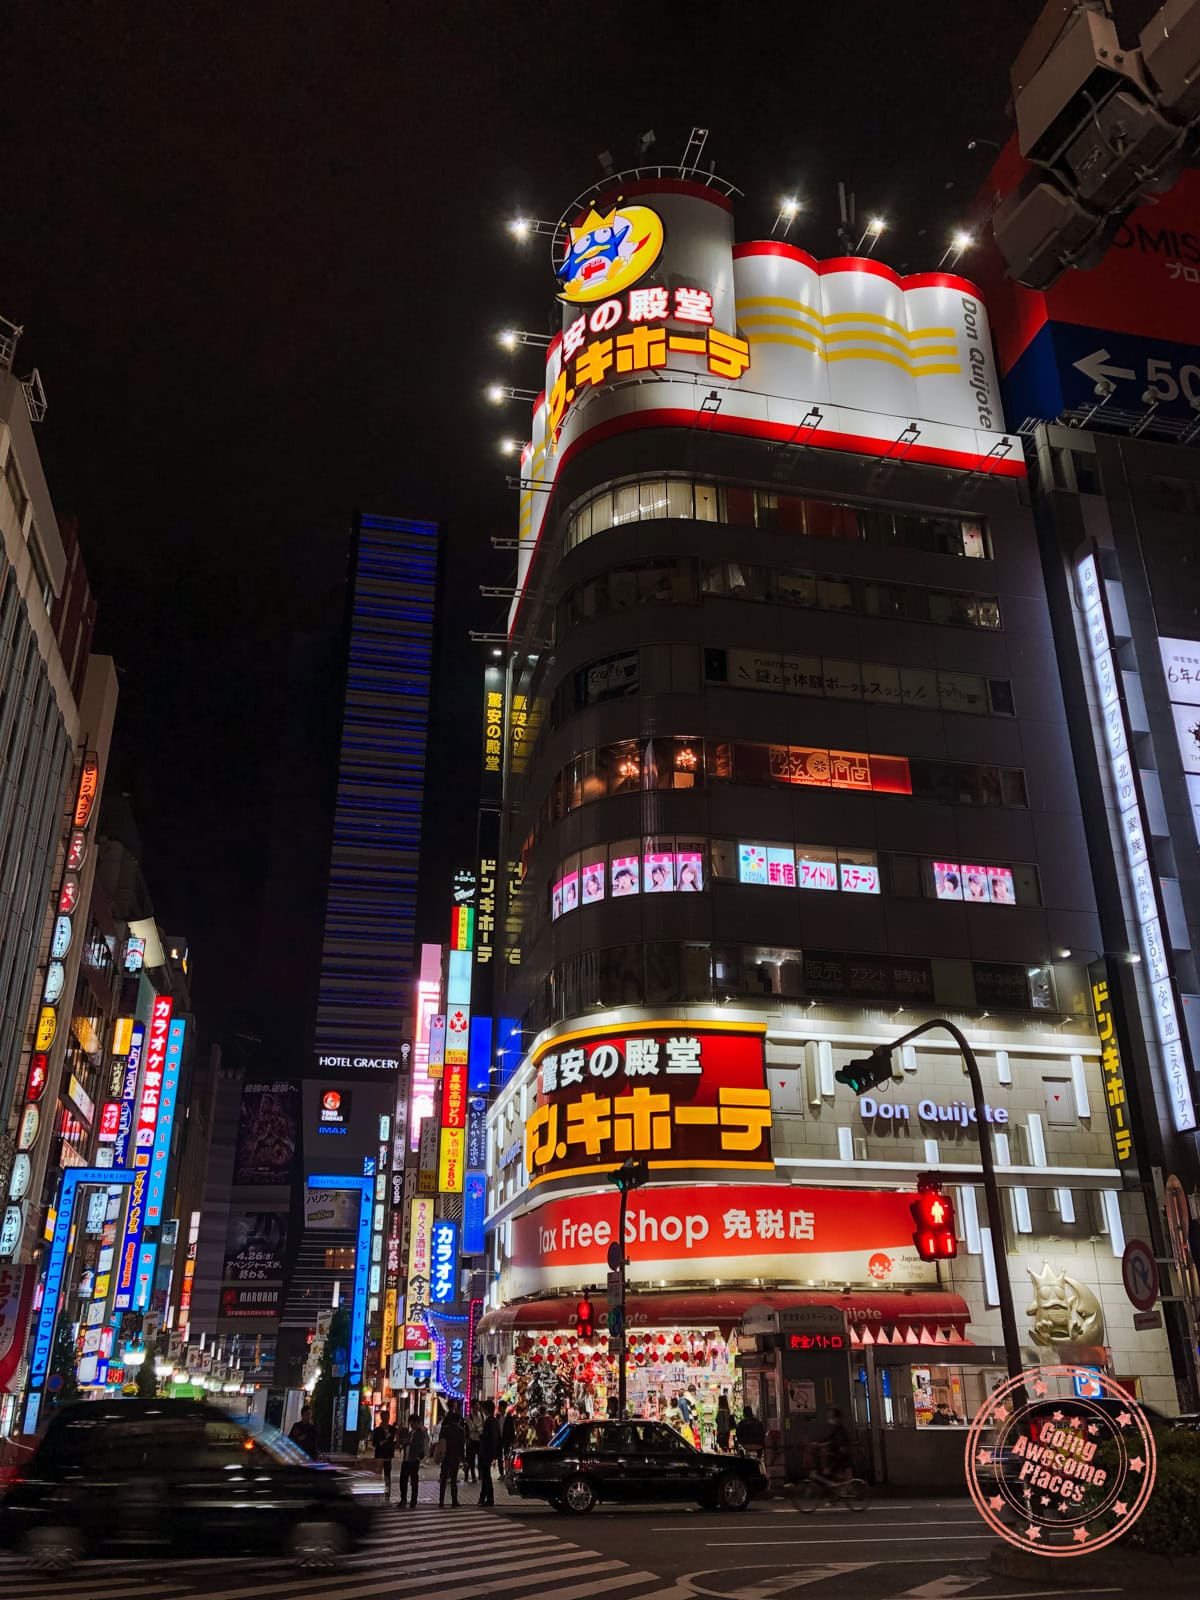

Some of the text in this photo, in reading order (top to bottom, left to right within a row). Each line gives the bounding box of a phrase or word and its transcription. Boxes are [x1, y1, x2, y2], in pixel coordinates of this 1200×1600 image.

[961, 297, 993, 430] Don Quijote
[484, 691, 502, 772] 驚安の殿堂
[769, 862, 876, 890] 新宿 アイドル ステージ
[477, 859, 497, 963] ドン・キホーテ
[1145, 926, 1161, 978] ESOLA
[1157, 985, 1176, 1037] ふぐ一郎
[140, 1001, 170, 1123] カラオケ歌広場
[319, 1056, 399, 1069] HOTEL GRACERY
[541, 1037, 702, 1094] 驚安の殿堂
[1092, 983, 1131, 1161] ドン・キホーテ
[1168, 1045, 1191, 1126] ミステリアス
[319, 1126, 347, 1134] IMAX
[526, 1087, 772, 1173] ドン・キホーテ
[860, 1098, 909, 1119] Don
[539, 1209, 709, 1255] Tax Free Shop
[723, 1208, 816, 1241] 免税店
[37, 1199, 72, 1355] GODZILLA ROAD
[435, 1225, 454, 1303] カラオケ
[240, 1291, 278, 1303] MARUHAN
[406, 1326, 421, 1341] 2F
[790, 1335, 843, 1348] 安全パトロ
[451, 1338, 463, 1388] カラオケ
